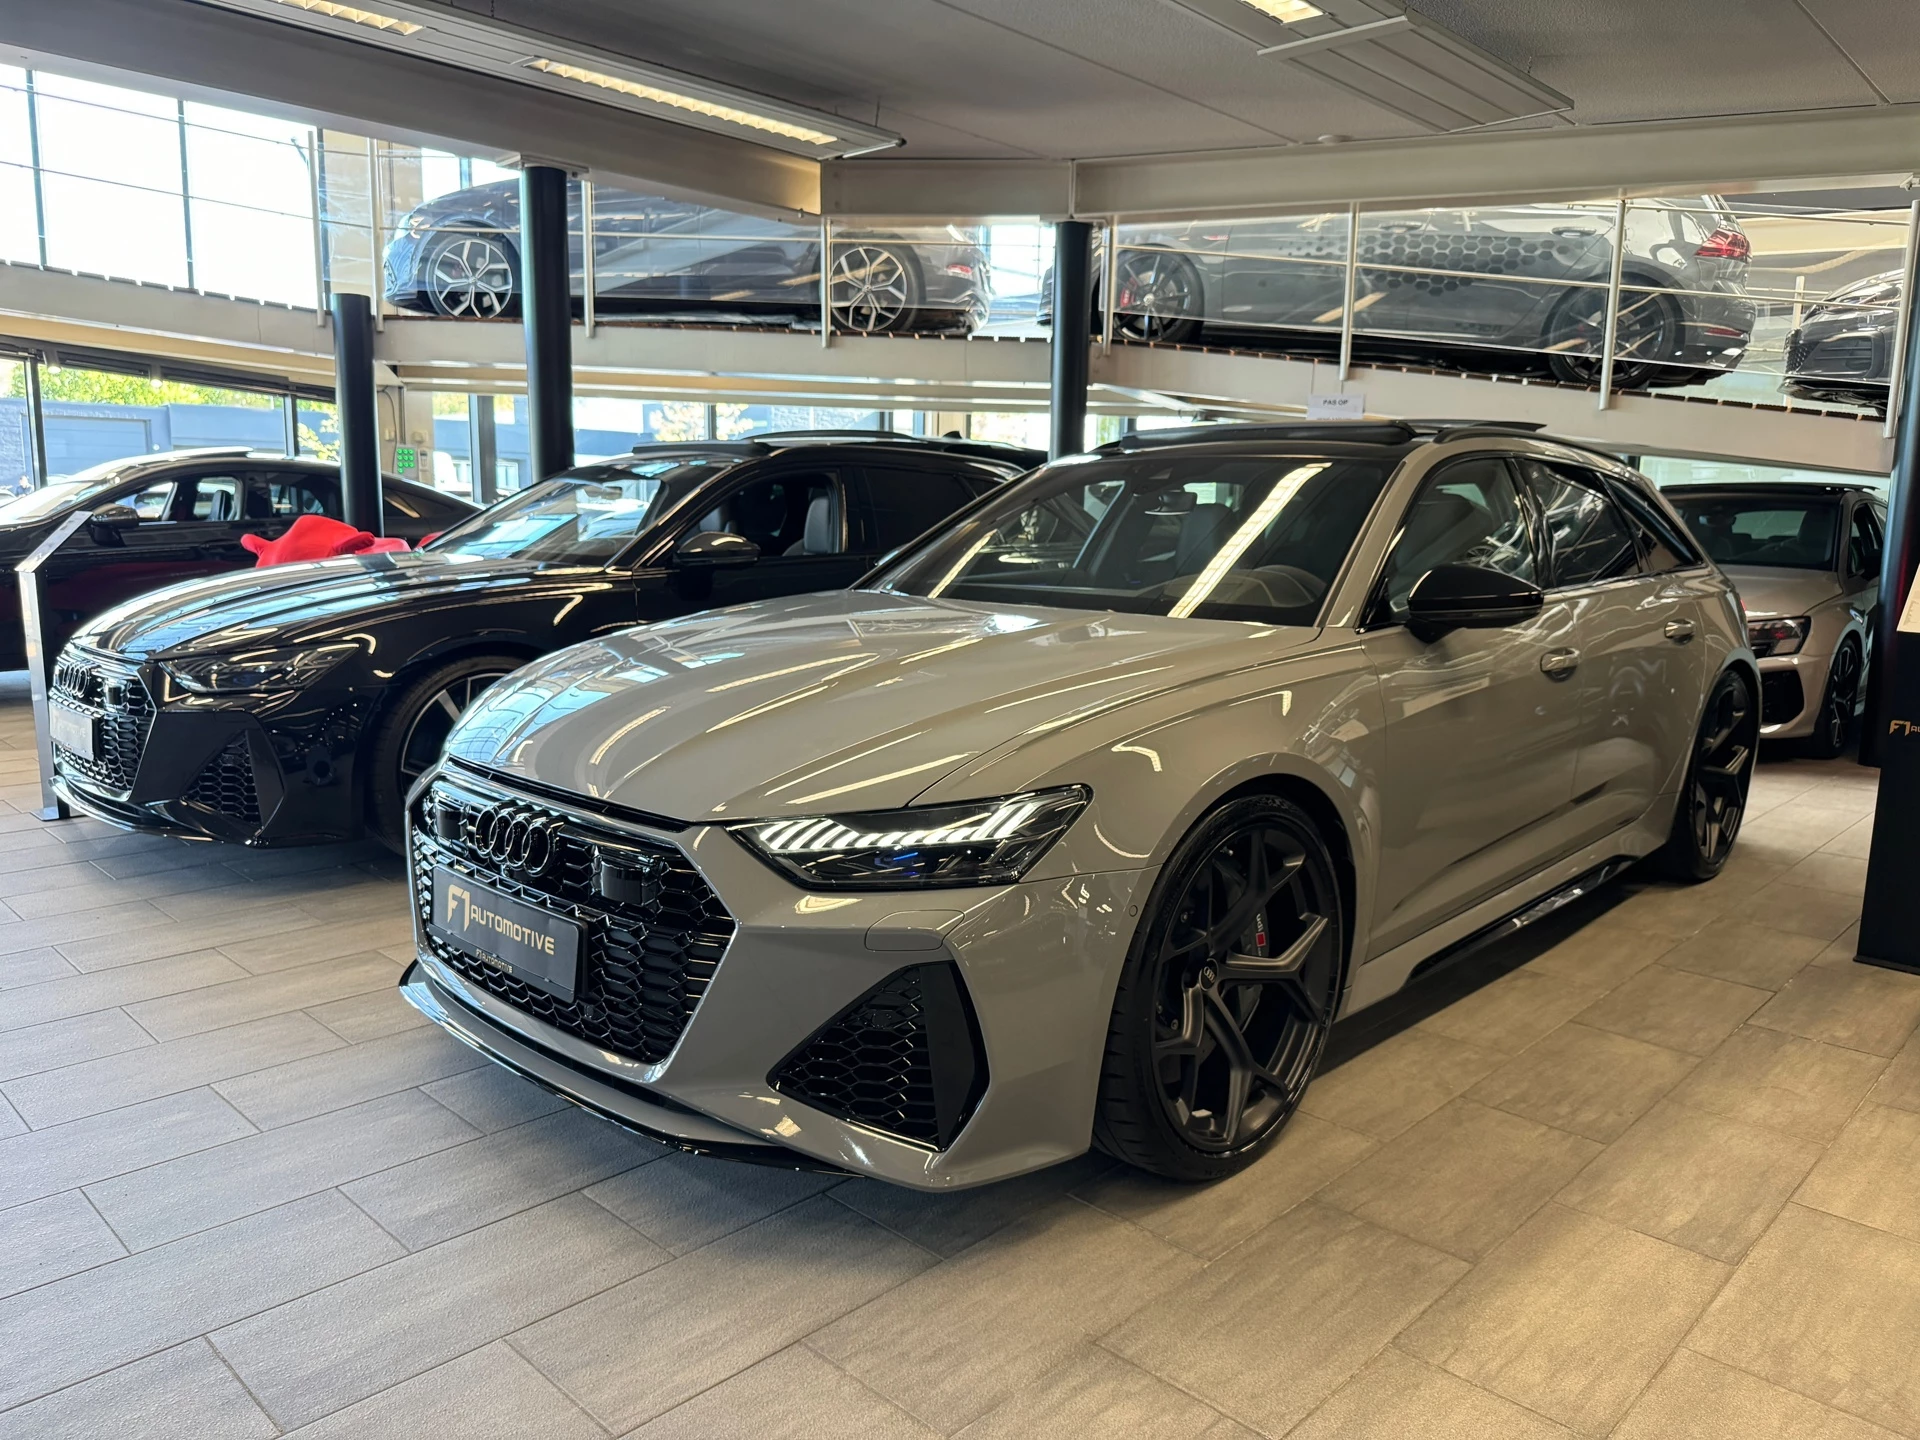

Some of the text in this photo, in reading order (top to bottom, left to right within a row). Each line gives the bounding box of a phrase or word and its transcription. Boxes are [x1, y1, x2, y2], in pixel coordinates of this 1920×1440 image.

[1889, 720, 1911, 736] F1
[447, 884, 554, 955] F1 AUTOMOTIVE
